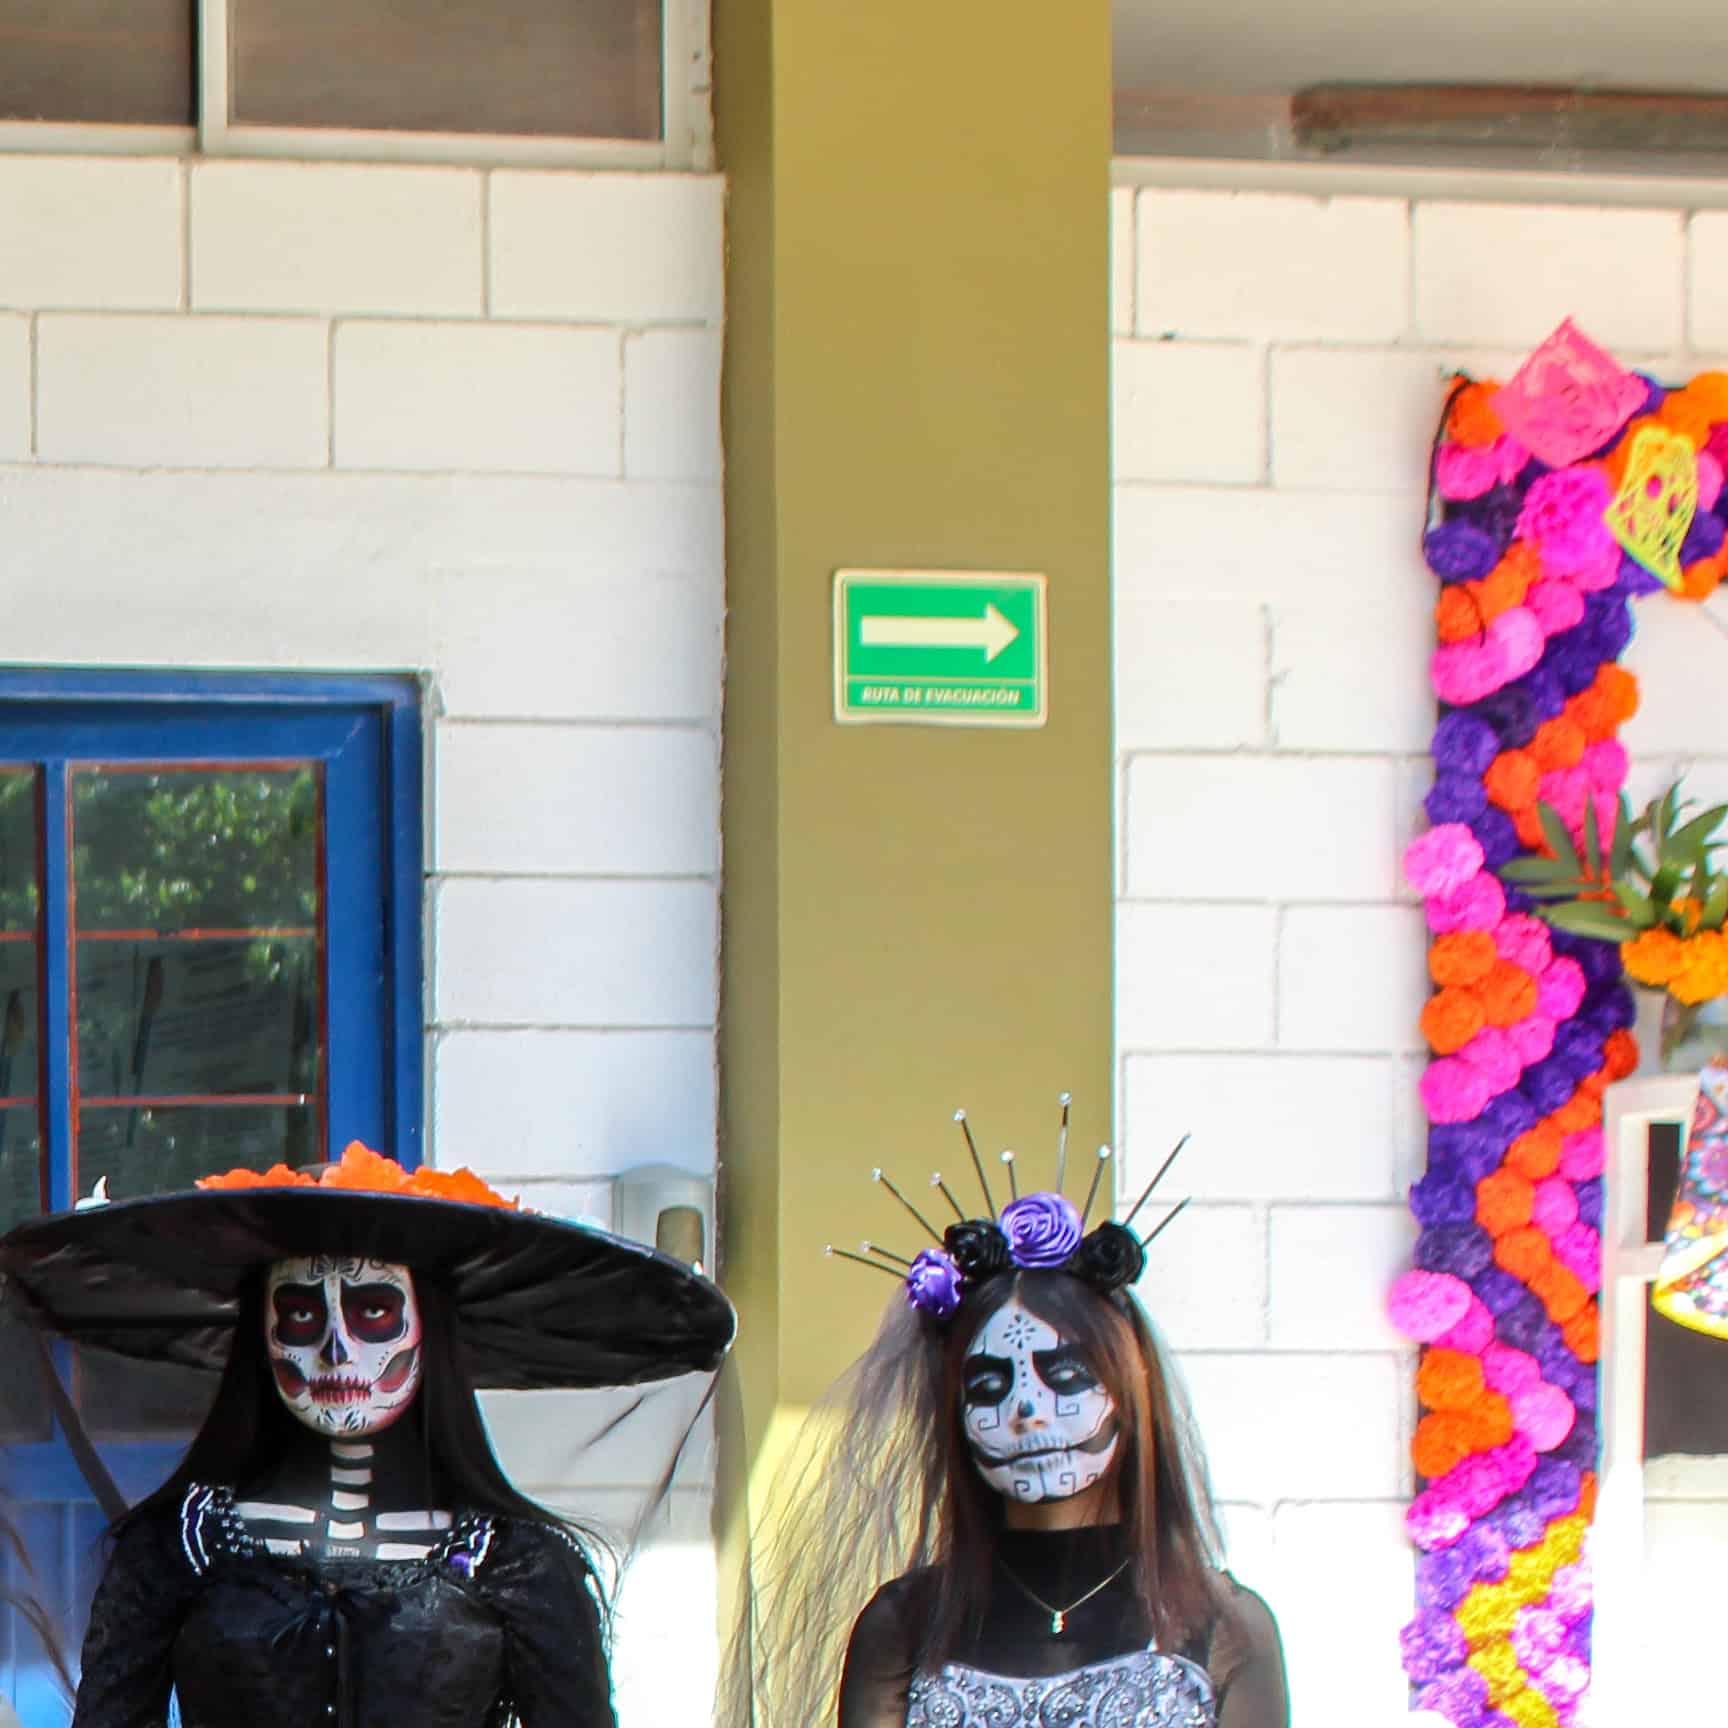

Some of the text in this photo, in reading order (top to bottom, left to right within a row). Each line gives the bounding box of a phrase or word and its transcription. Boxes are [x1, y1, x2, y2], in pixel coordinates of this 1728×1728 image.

[861, 686, 1022, 705] RUTA DE EVACUACIÓN
